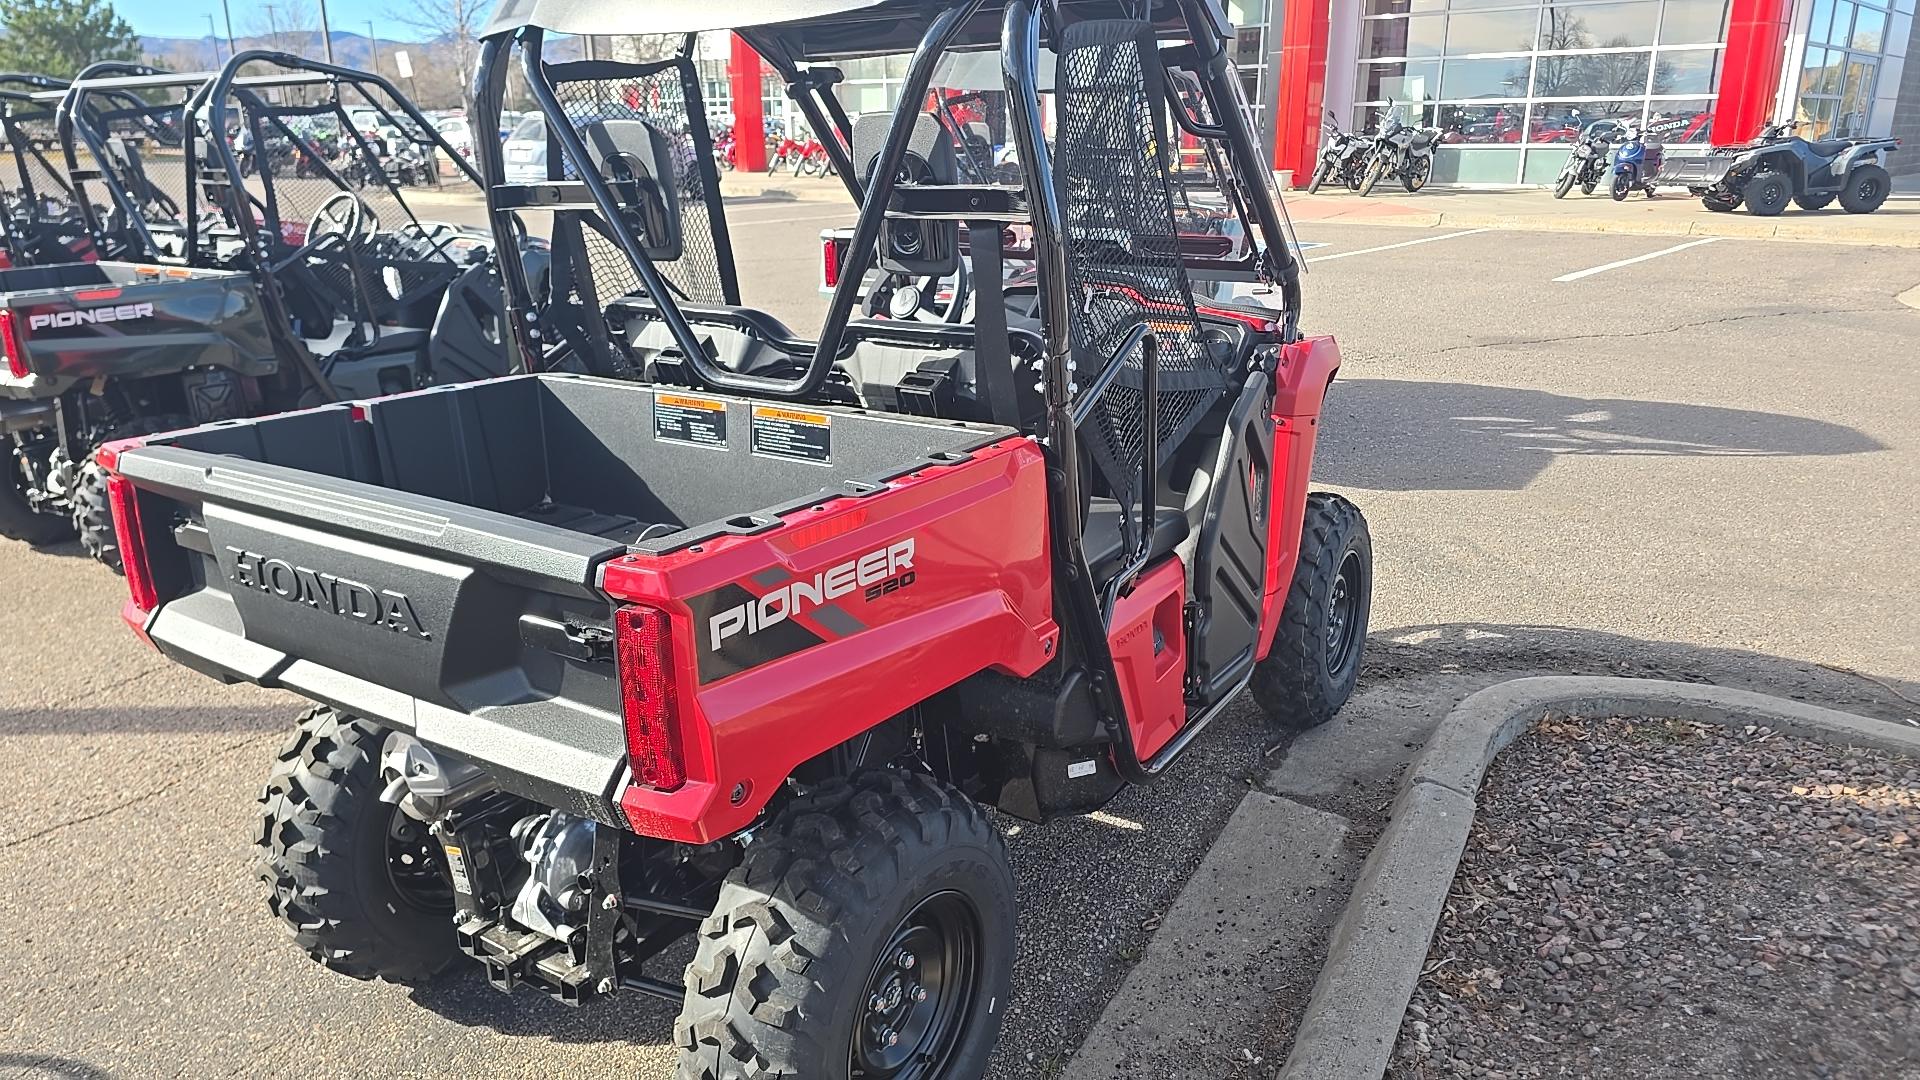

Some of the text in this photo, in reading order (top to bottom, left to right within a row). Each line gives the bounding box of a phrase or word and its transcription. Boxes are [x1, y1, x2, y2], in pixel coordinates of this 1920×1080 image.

[29, 302, 154, 331] PIONEER
[678, 398, 705, 408] WARNING
[226, 545, 433, 642] HONDA
[709, 537, 915, 652] PIONEER
[864, 571, 916, 603] 520
